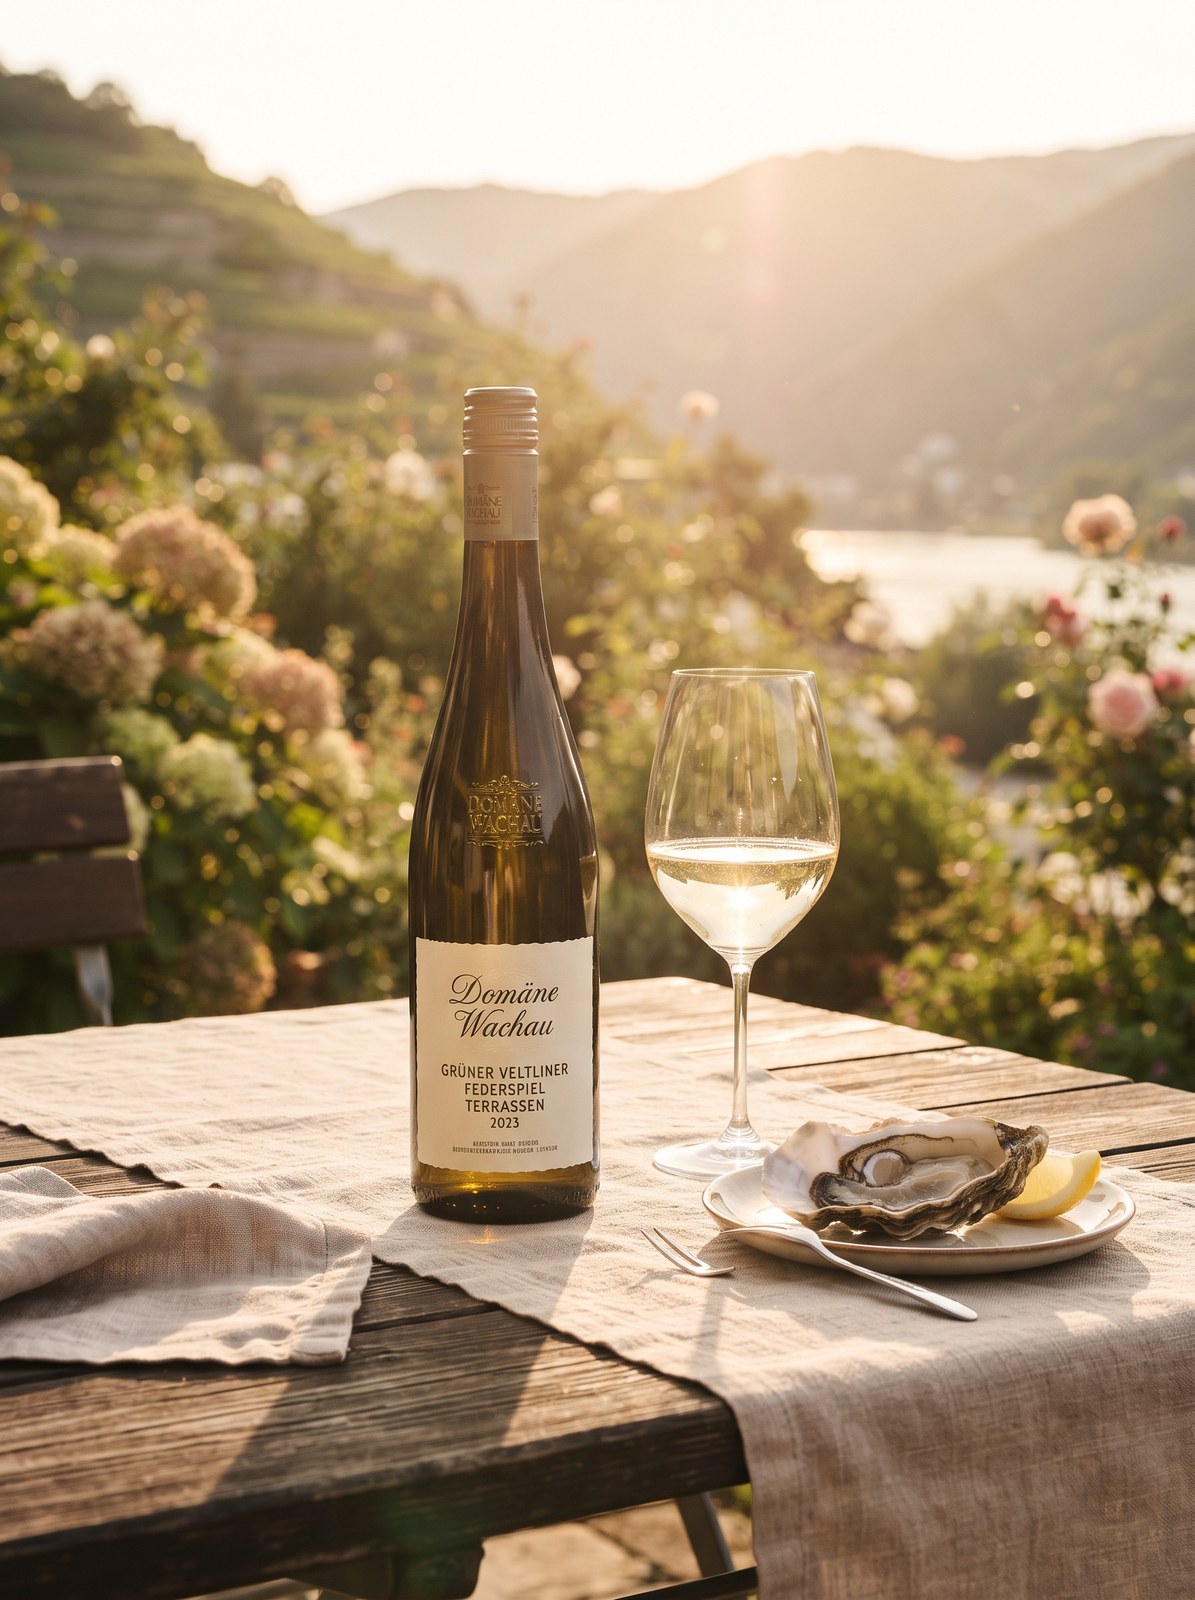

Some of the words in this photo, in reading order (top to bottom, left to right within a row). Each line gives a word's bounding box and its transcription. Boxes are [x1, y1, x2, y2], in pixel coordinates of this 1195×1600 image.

[468, 814, 543, 833] WACHAU
[448, 973, 559, 1005] Domäne
[453, 1007, 554, 1038] Wachau
[441, 1062, 494, 1079] GRÜNER
[498, 1062, 569, 1080] VELTLINER
[464, 1082, 546, 1096] FEDERSPIEL
[465, 1098, 545, 1113] TERRASSEN
[489, 1117, 520, 1129] 2023
